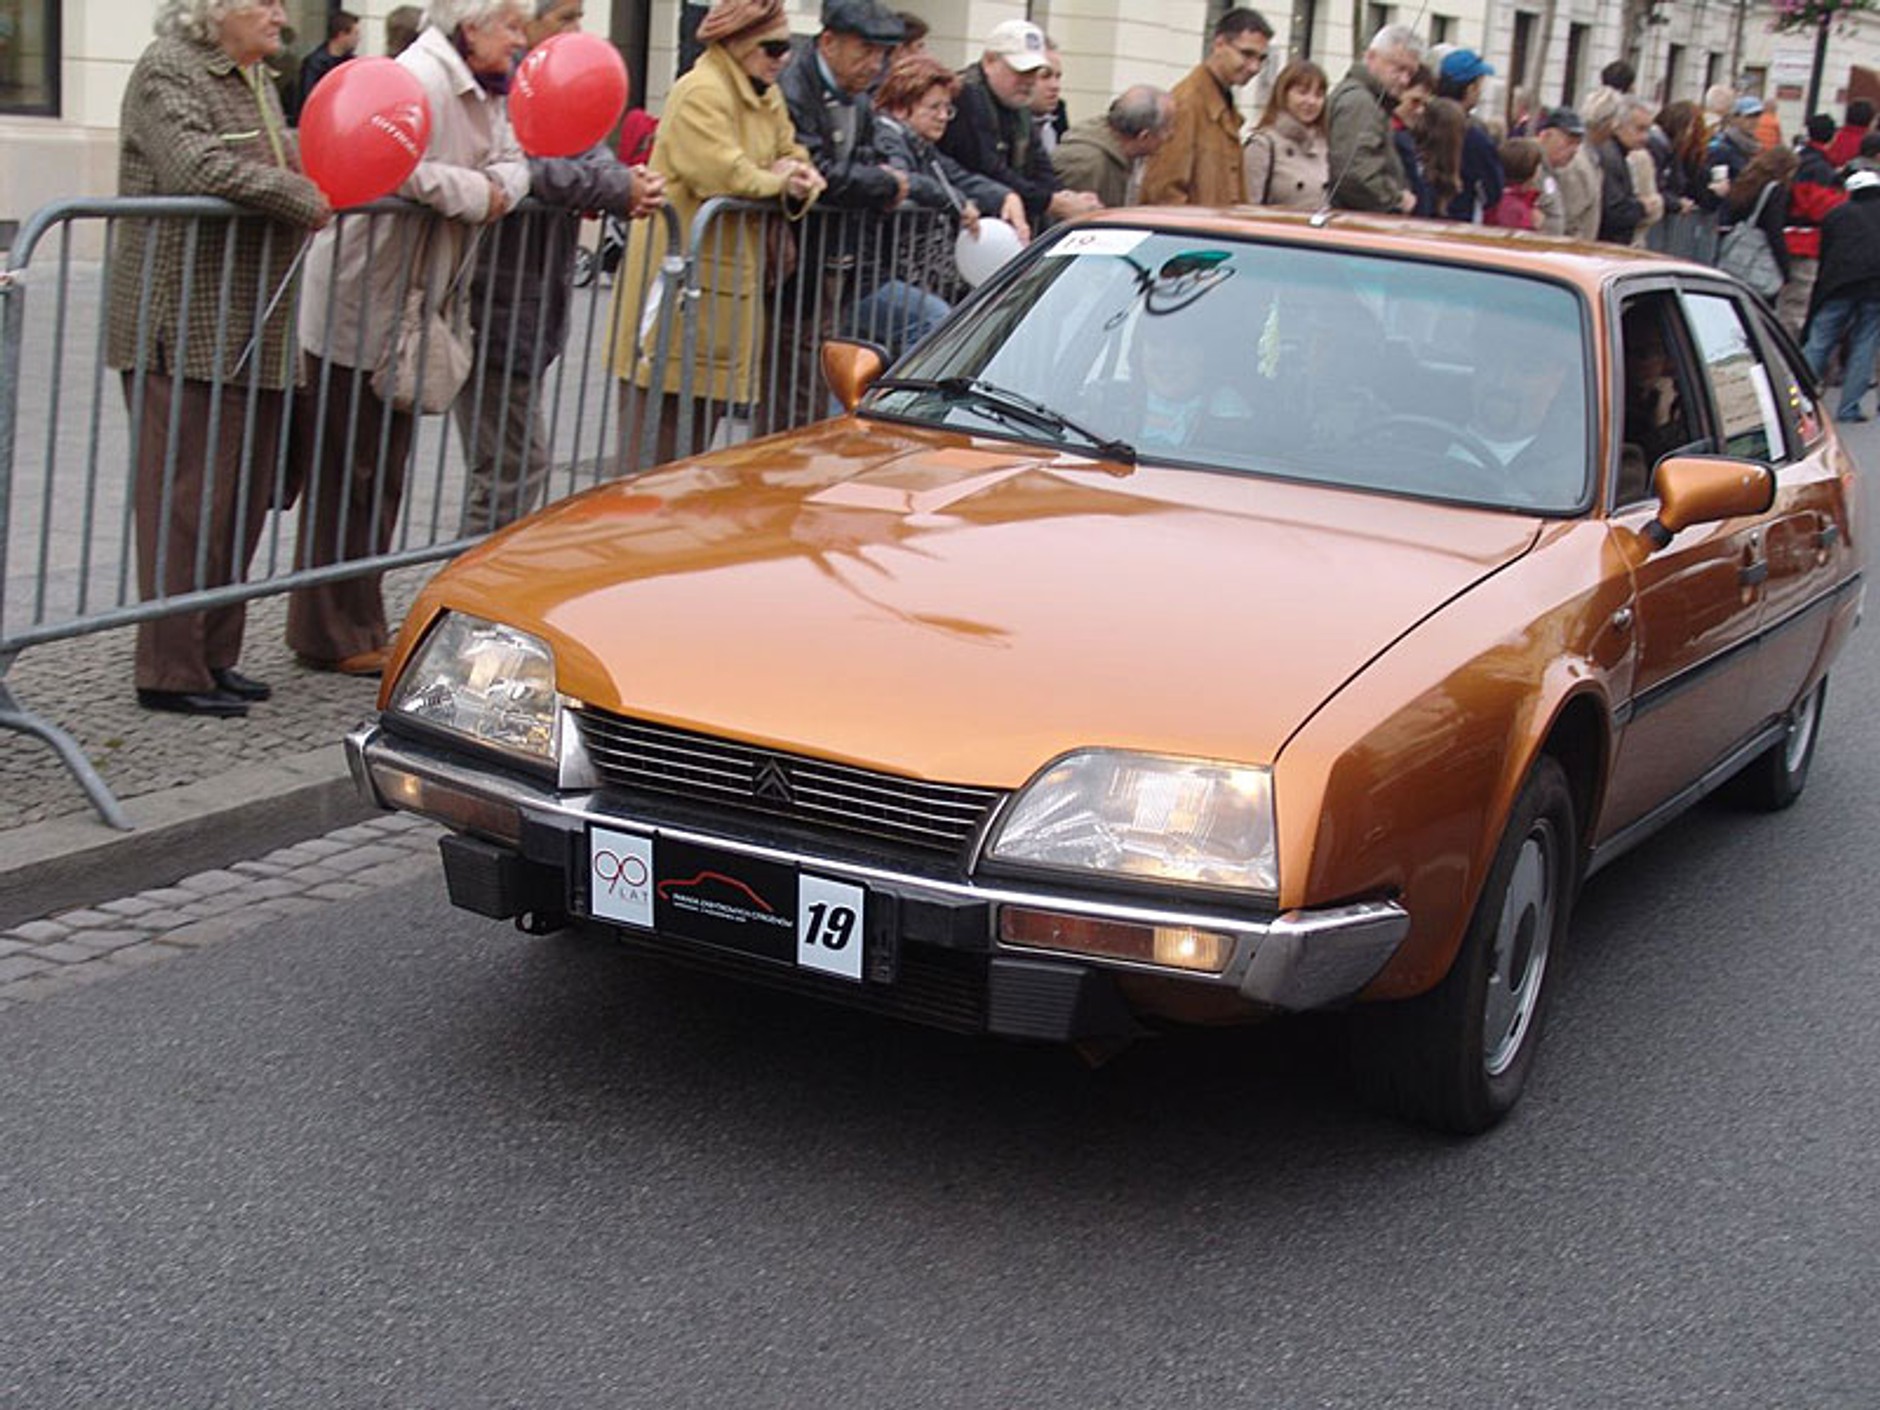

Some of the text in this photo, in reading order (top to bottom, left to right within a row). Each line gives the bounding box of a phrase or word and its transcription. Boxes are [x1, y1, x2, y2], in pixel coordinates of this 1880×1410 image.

[595, 851, 647, 894] 90
[619, 888, 649, 903] LAT
[805, 902, 856, 950] 19
